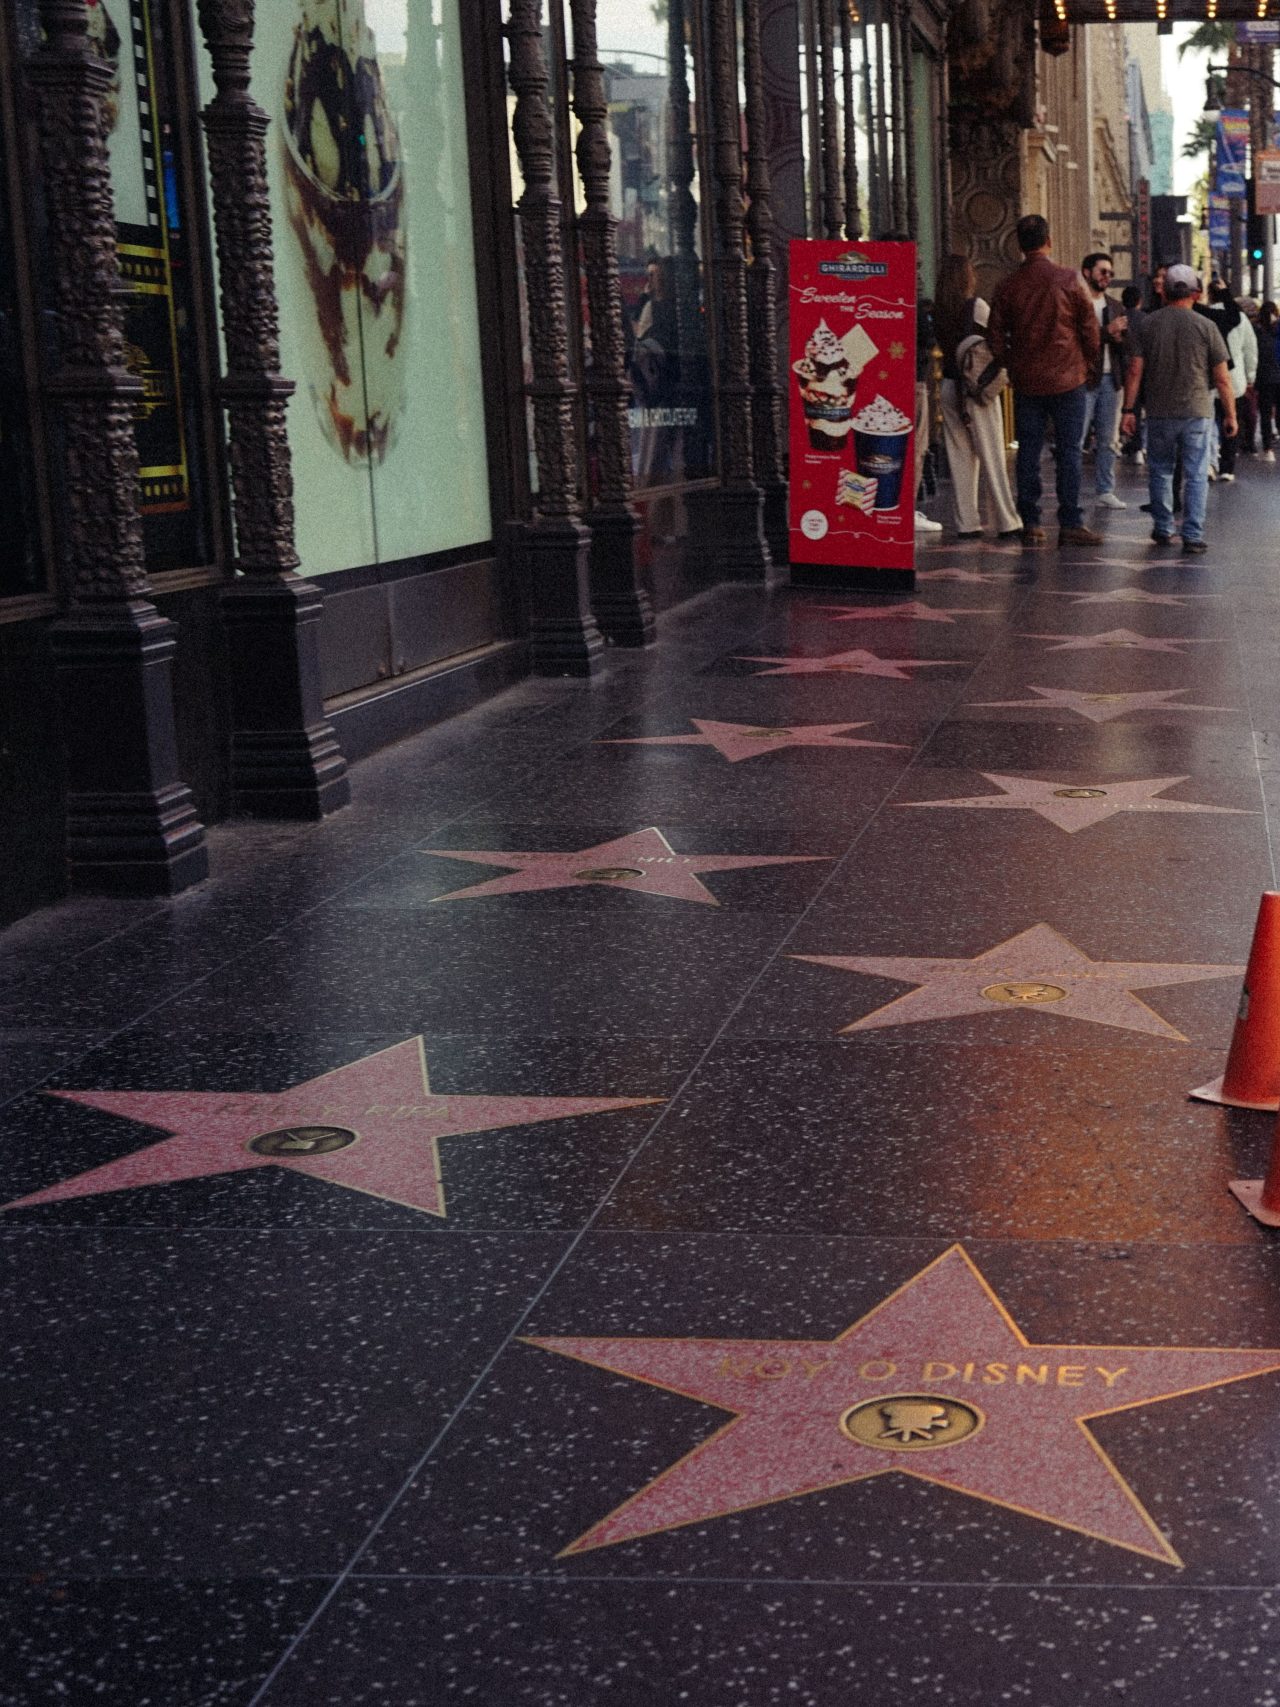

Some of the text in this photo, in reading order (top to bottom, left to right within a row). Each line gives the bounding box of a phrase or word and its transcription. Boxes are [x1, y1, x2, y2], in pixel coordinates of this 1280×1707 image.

[821, 264, 886, 274] GHIRARDELLI
[801, 287, 857, 303] Sweeten
[855, 303, 905, 319] Season
[718, 1358, 1128, 1388] ROY O DISNEY
